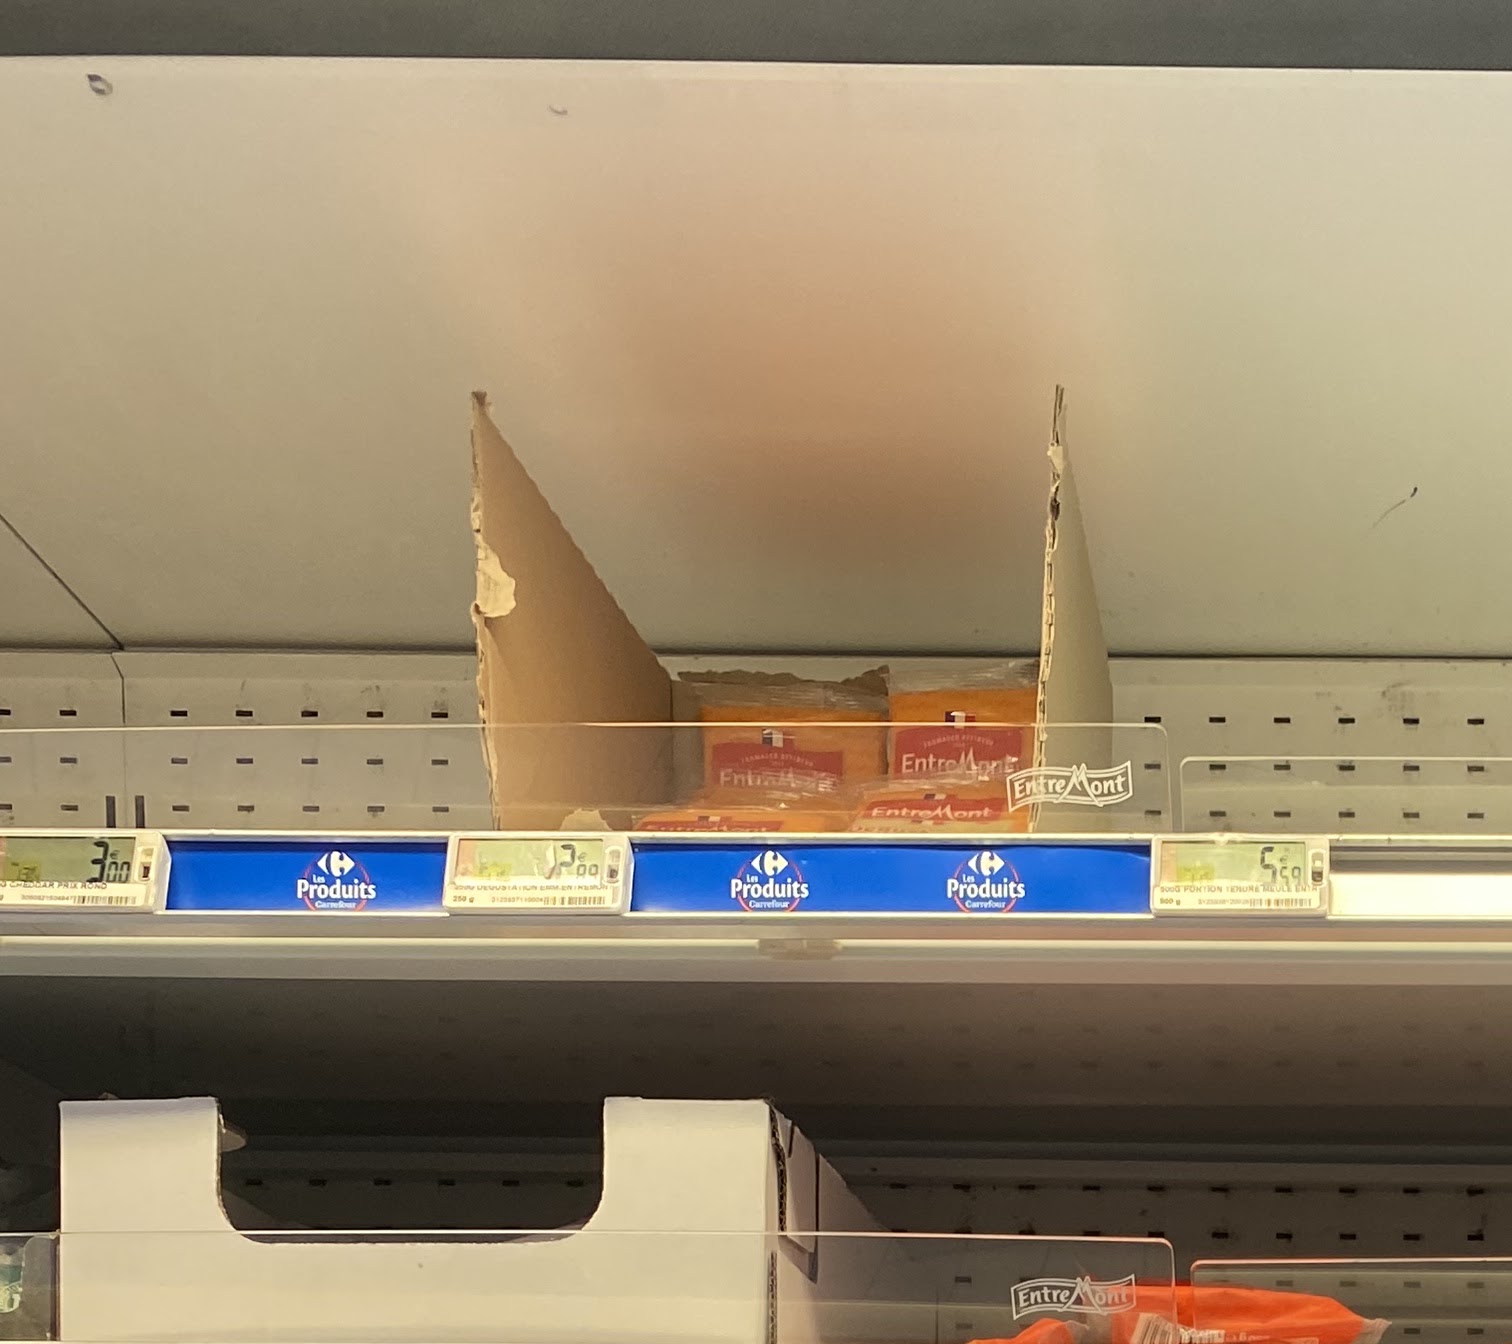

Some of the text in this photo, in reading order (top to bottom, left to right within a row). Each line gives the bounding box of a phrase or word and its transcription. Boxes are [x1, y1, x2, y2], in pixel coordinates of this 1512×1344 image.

[1014, 764, 1126, 806] EntreMont
[313, 874, 325, 882] Les
[297, 879, 376, 901] Produits
[731, 879, 809, 899] Produits
[315, 900, 355, 909] Carrefour
[749, 900, 789, 909] Carrefour
[1019, 1276, 1128, 1314] EntreMont
